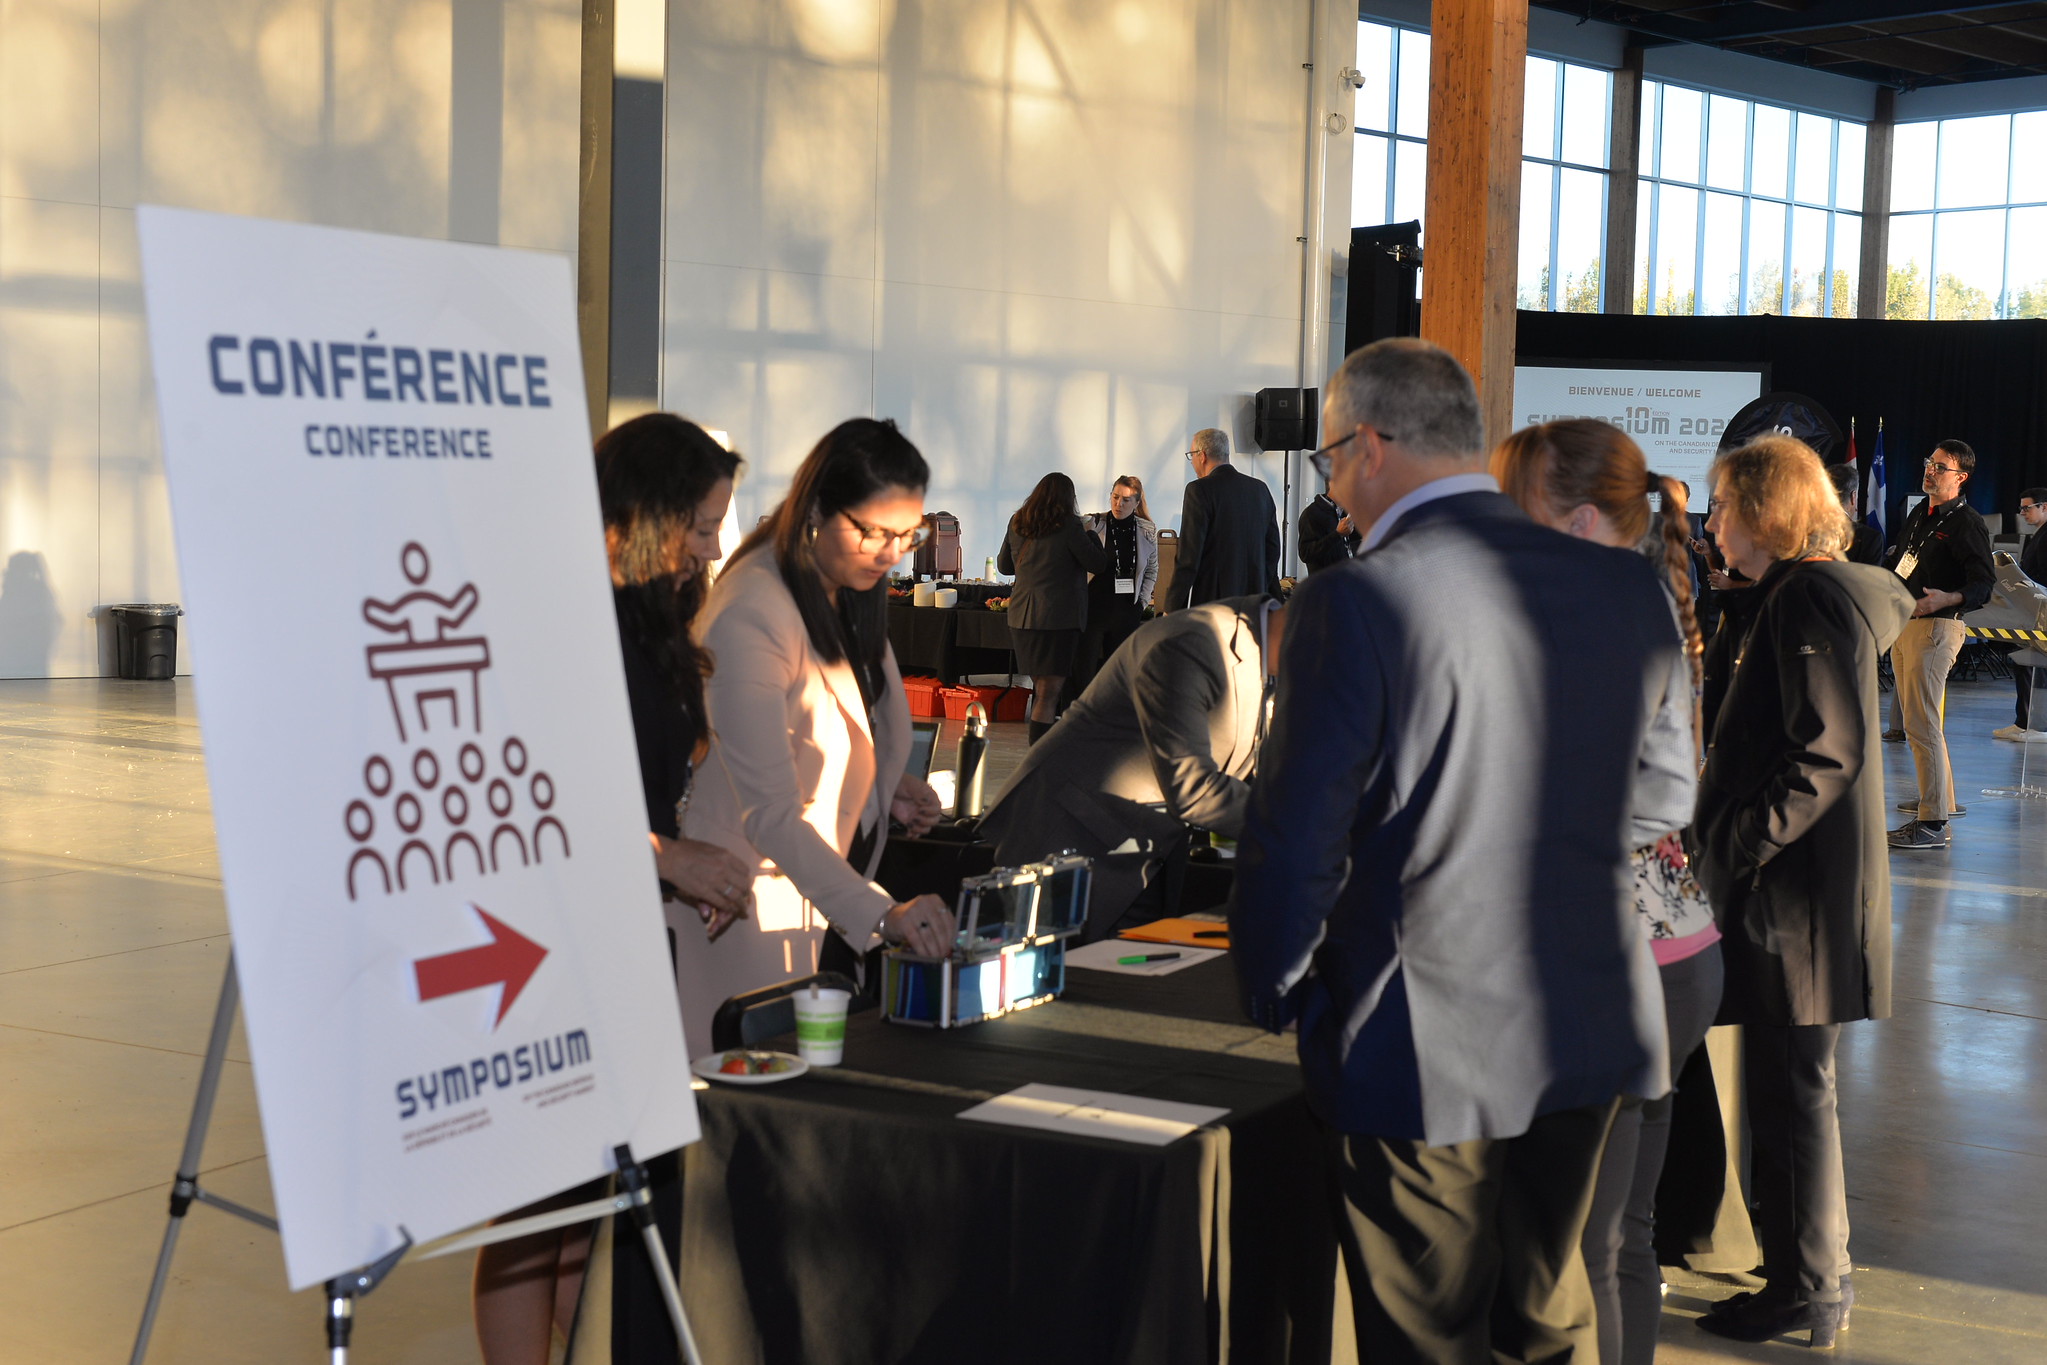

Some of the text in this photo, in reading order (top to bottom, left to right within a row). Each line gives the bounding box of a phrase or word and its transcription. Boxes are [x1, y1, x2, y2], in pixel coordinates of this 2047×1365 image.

[208, 328, 552, 408] CONFÉRENCE
[1568, 386, 1634, 397] BIENVENUE
[1645, 388, 1701, 398] WELCOME
[305, 424, 493, 459] CONFERENCE
[1679, 417, 1732, 436] 202
[395, 1028, 592, 1120] SYMPOSIUM
